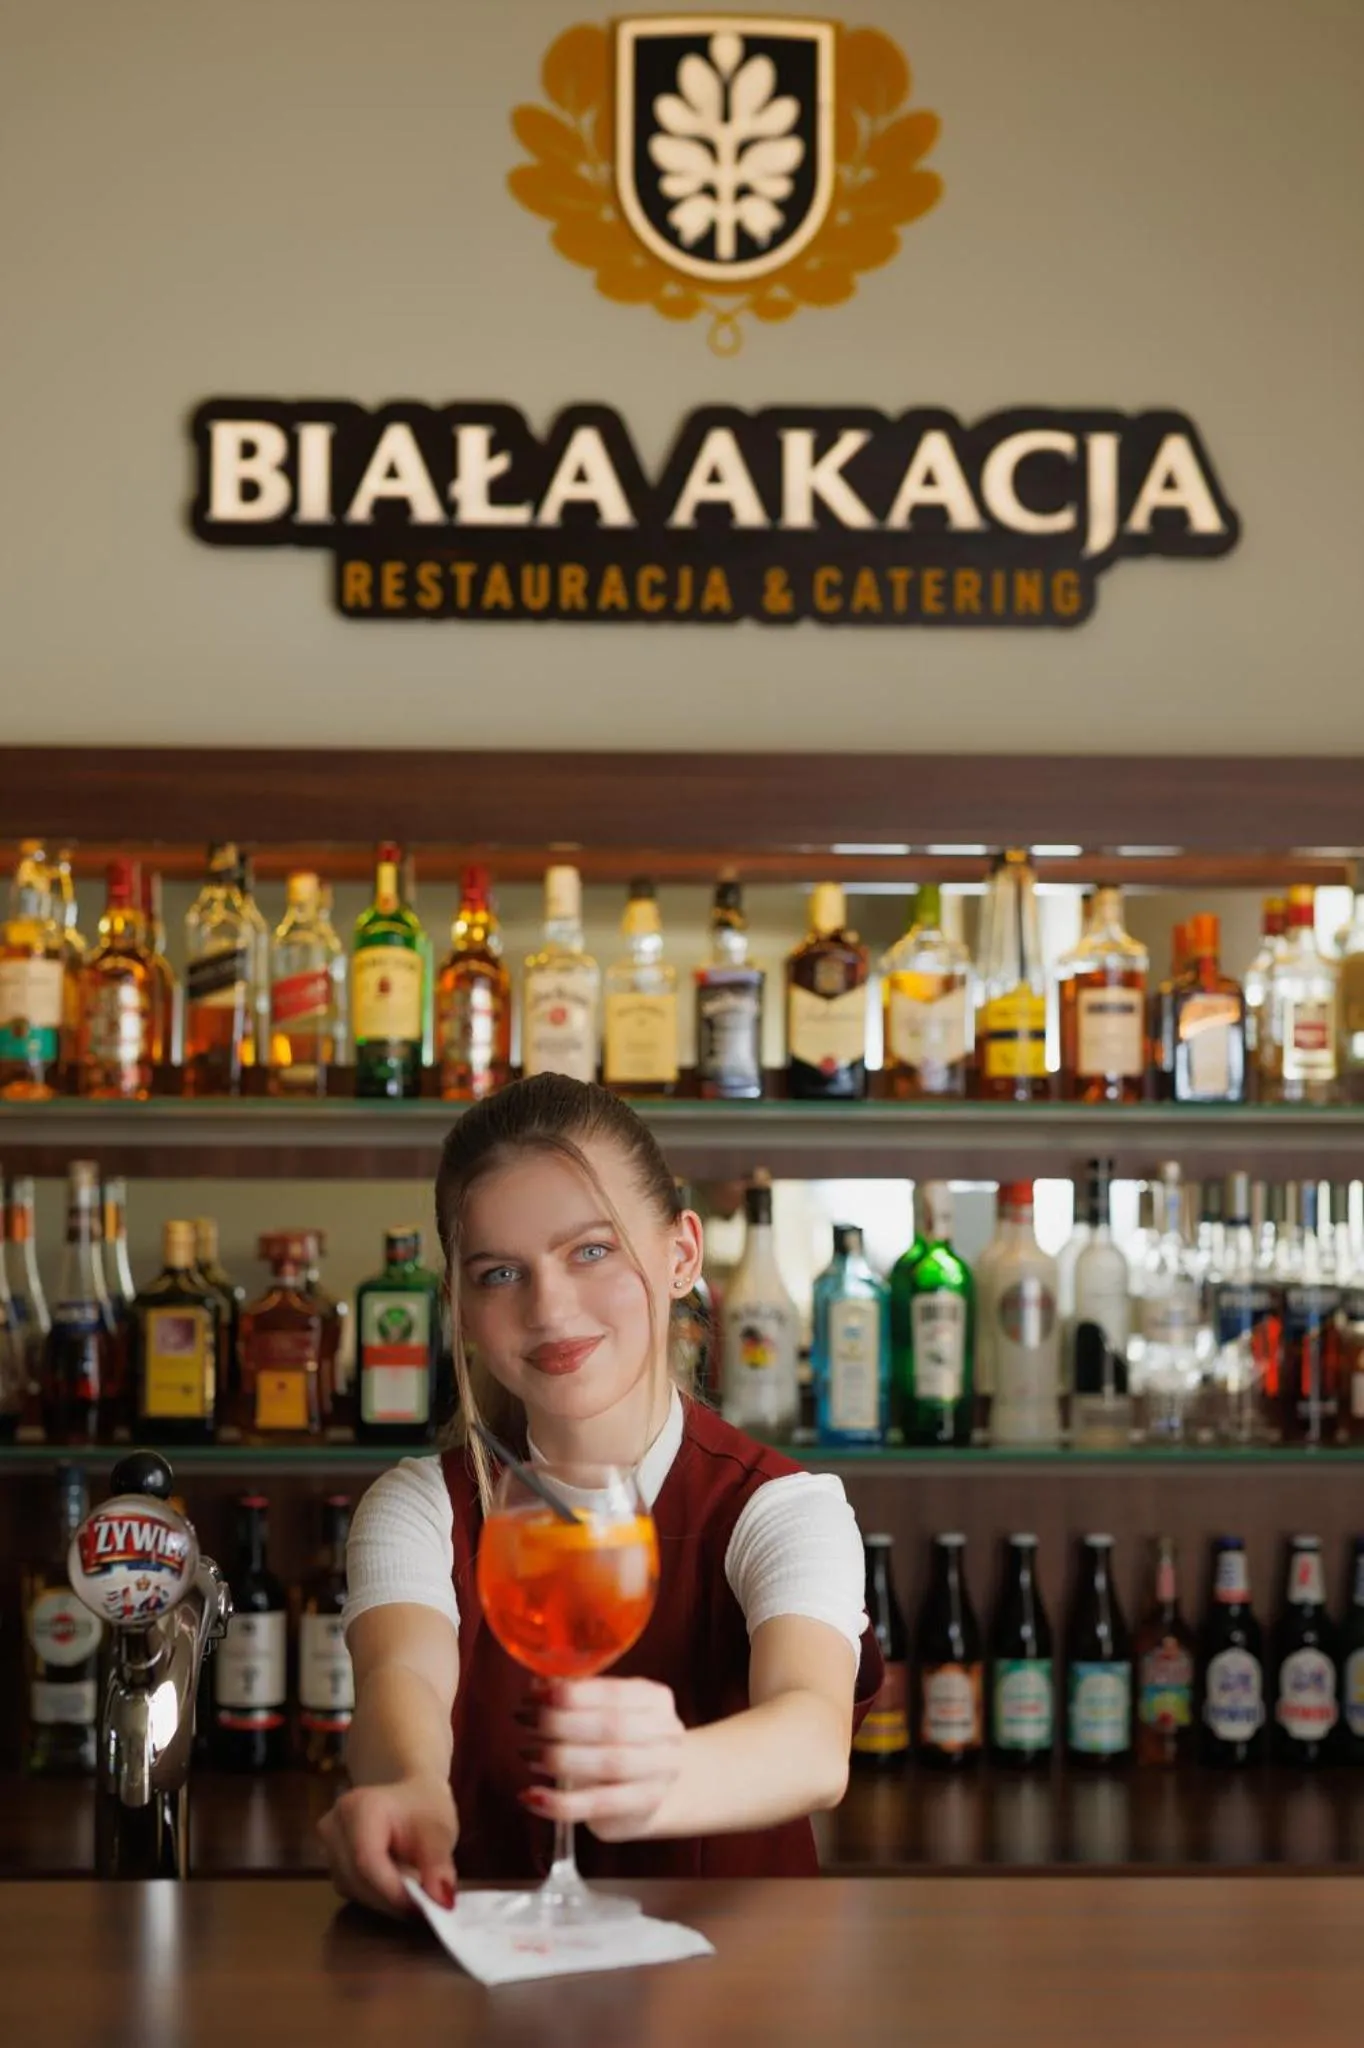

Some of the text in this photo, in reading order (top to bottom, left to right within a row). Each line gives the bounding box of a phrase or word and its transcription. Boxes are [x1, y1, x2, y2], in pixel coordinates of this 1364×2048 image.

[207, 421, 1225, 556] BIAŁA AKACJA
[343, 561, 1083, 617] RESTAURACJA & CATERING
